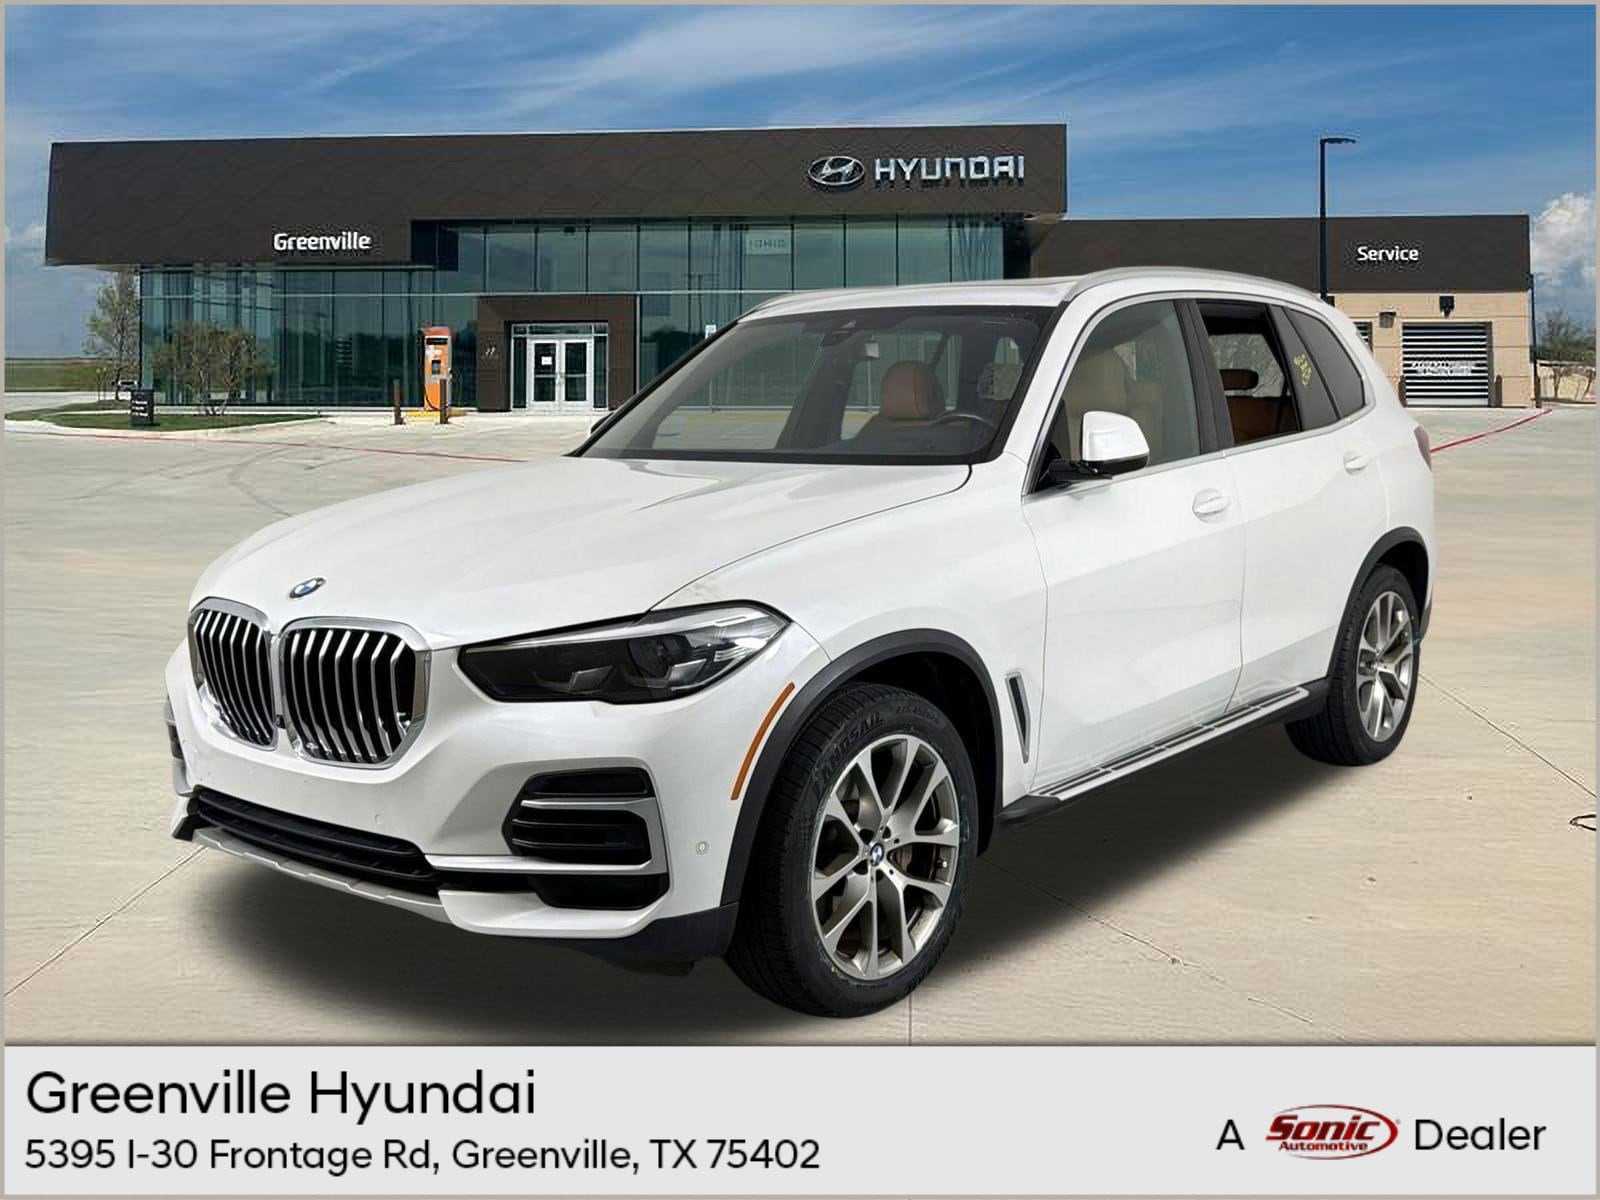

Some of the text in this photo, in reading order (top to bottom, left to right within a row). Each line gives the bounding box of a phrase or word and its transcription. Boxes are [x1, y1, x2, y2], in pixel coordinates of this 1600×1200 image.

[874, 155, 1025, 181] HYUNDAI
[273, 231, 371, 252] Greenville
[1356, 245, 1419, 262] Service
